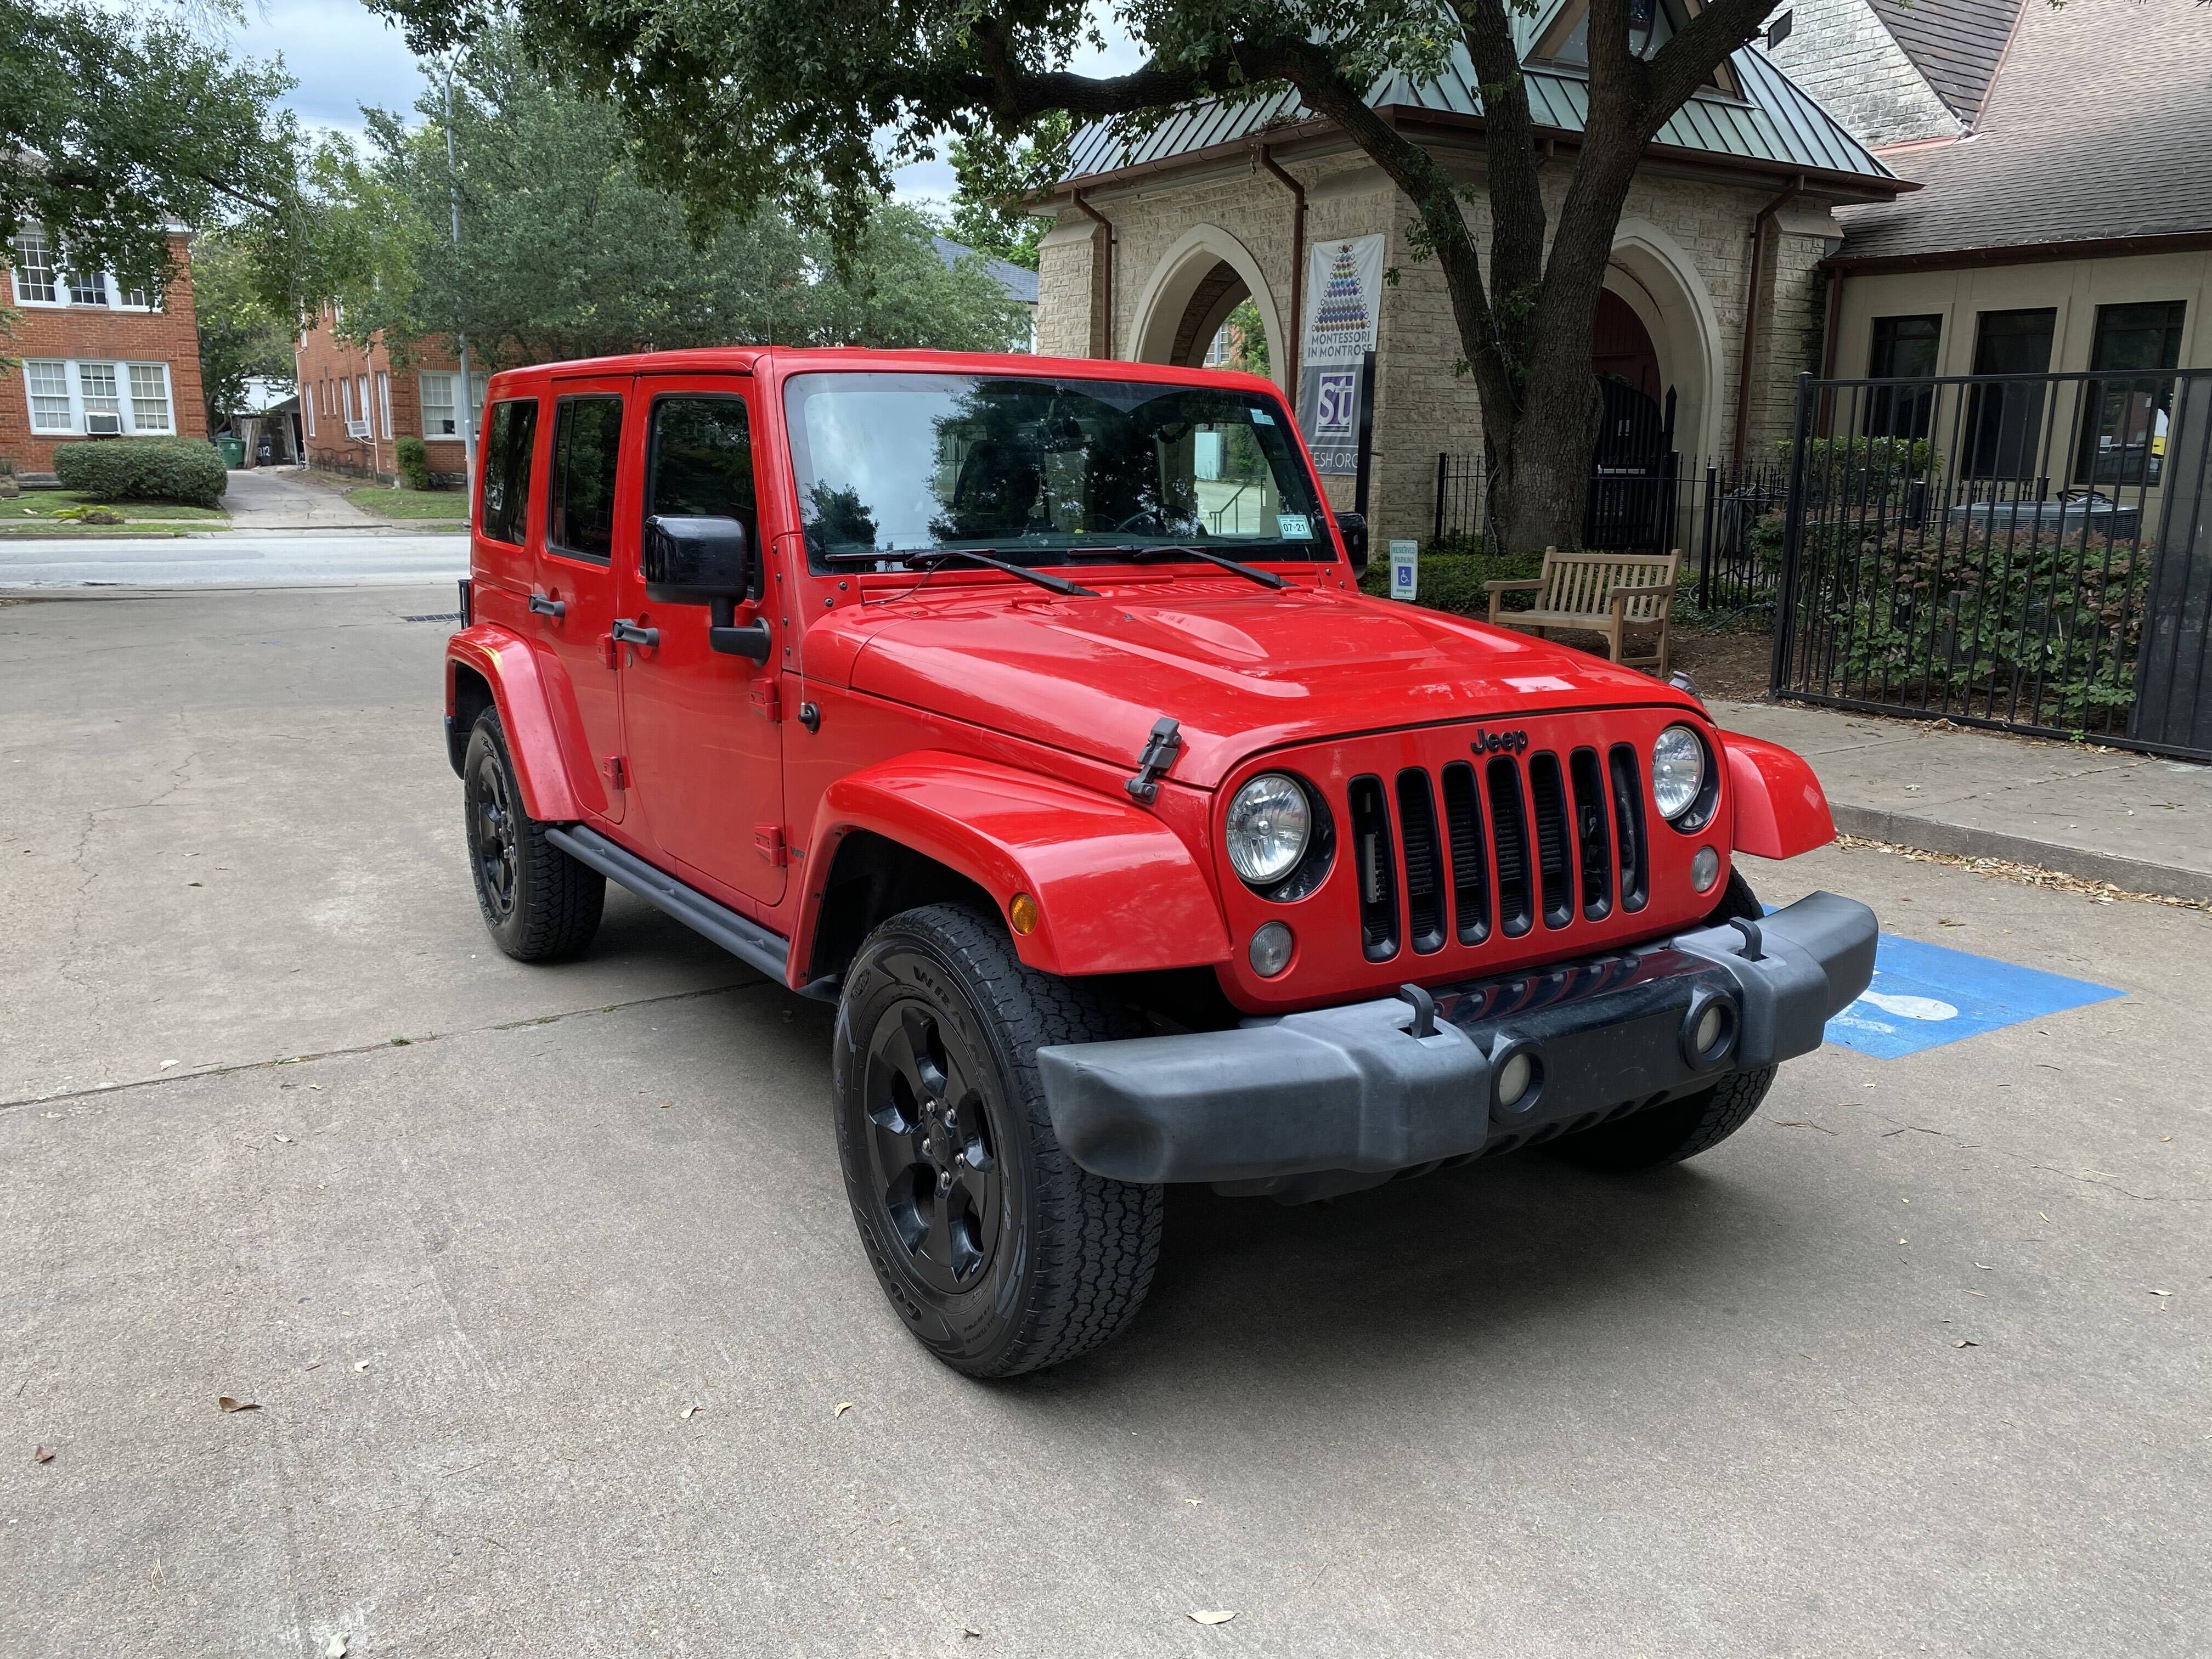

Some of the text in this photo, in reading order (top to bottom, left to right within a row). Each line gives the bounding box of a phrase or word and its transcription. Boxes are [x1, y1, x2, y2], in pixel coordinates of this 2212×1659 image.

[1312, 331, 1370, 345] MONTESSORI
[1308, 344, 1373, 358] IN MONTROSE
[1309, 452, 1358, 468] ESH.ORG
[1470, 728, 1528, 755] Jeep
